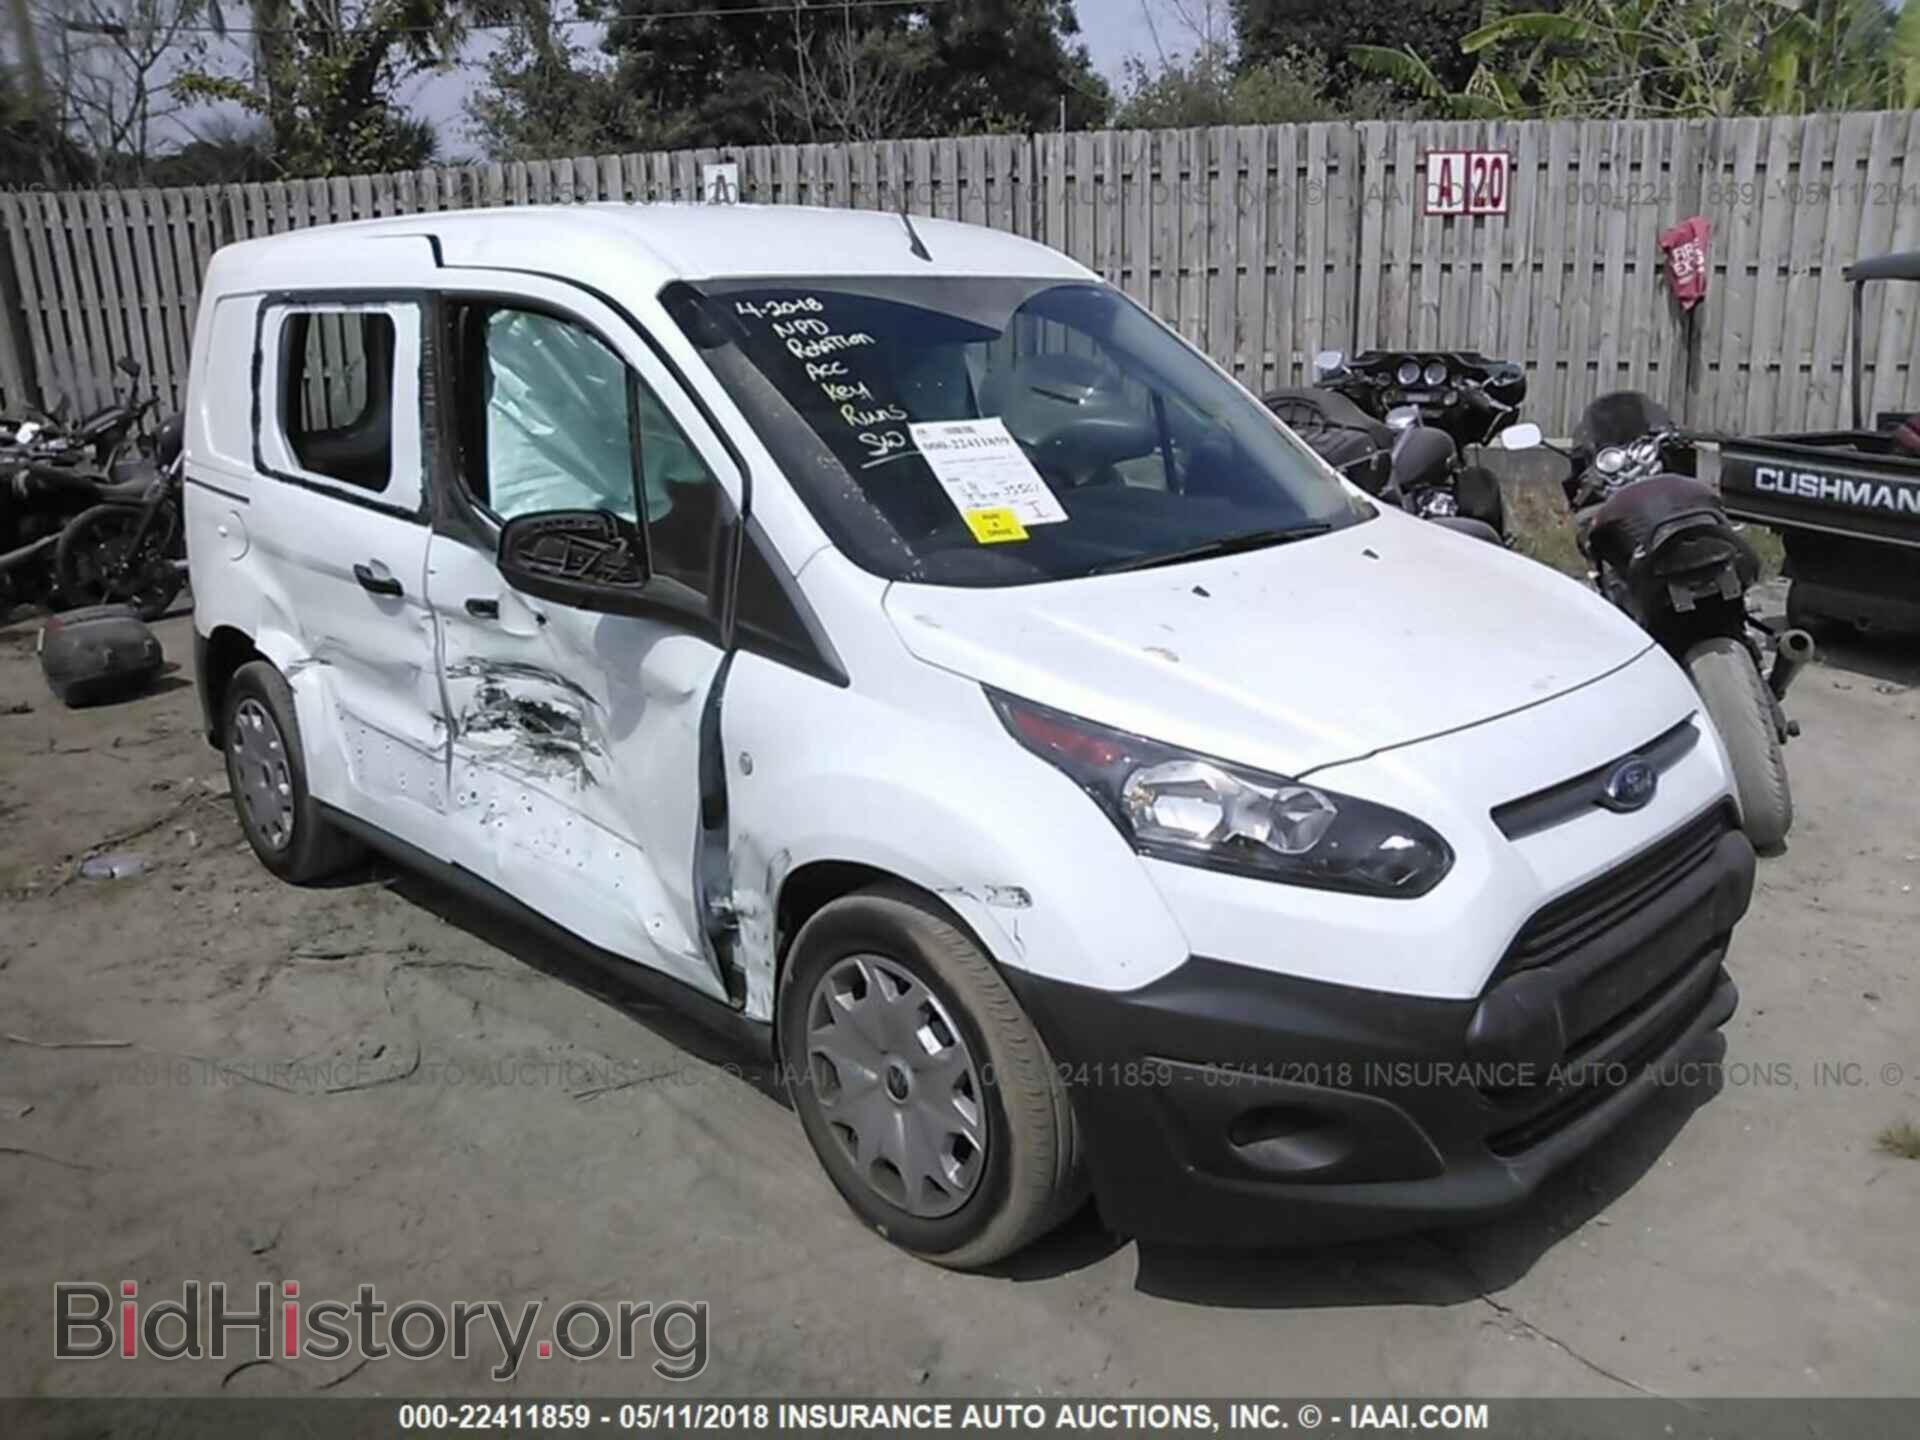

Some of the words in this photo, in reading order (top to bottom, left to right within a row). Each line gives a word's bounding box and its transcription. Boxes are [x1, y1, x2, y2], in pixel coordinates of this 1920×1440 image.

[1438, 157, 1452, 208] A
[1473, 157, 1503, 208] 20
[735, 297, 823, 318] 4-2018
[1755, 466, 1920, 513] CUSHMAN
